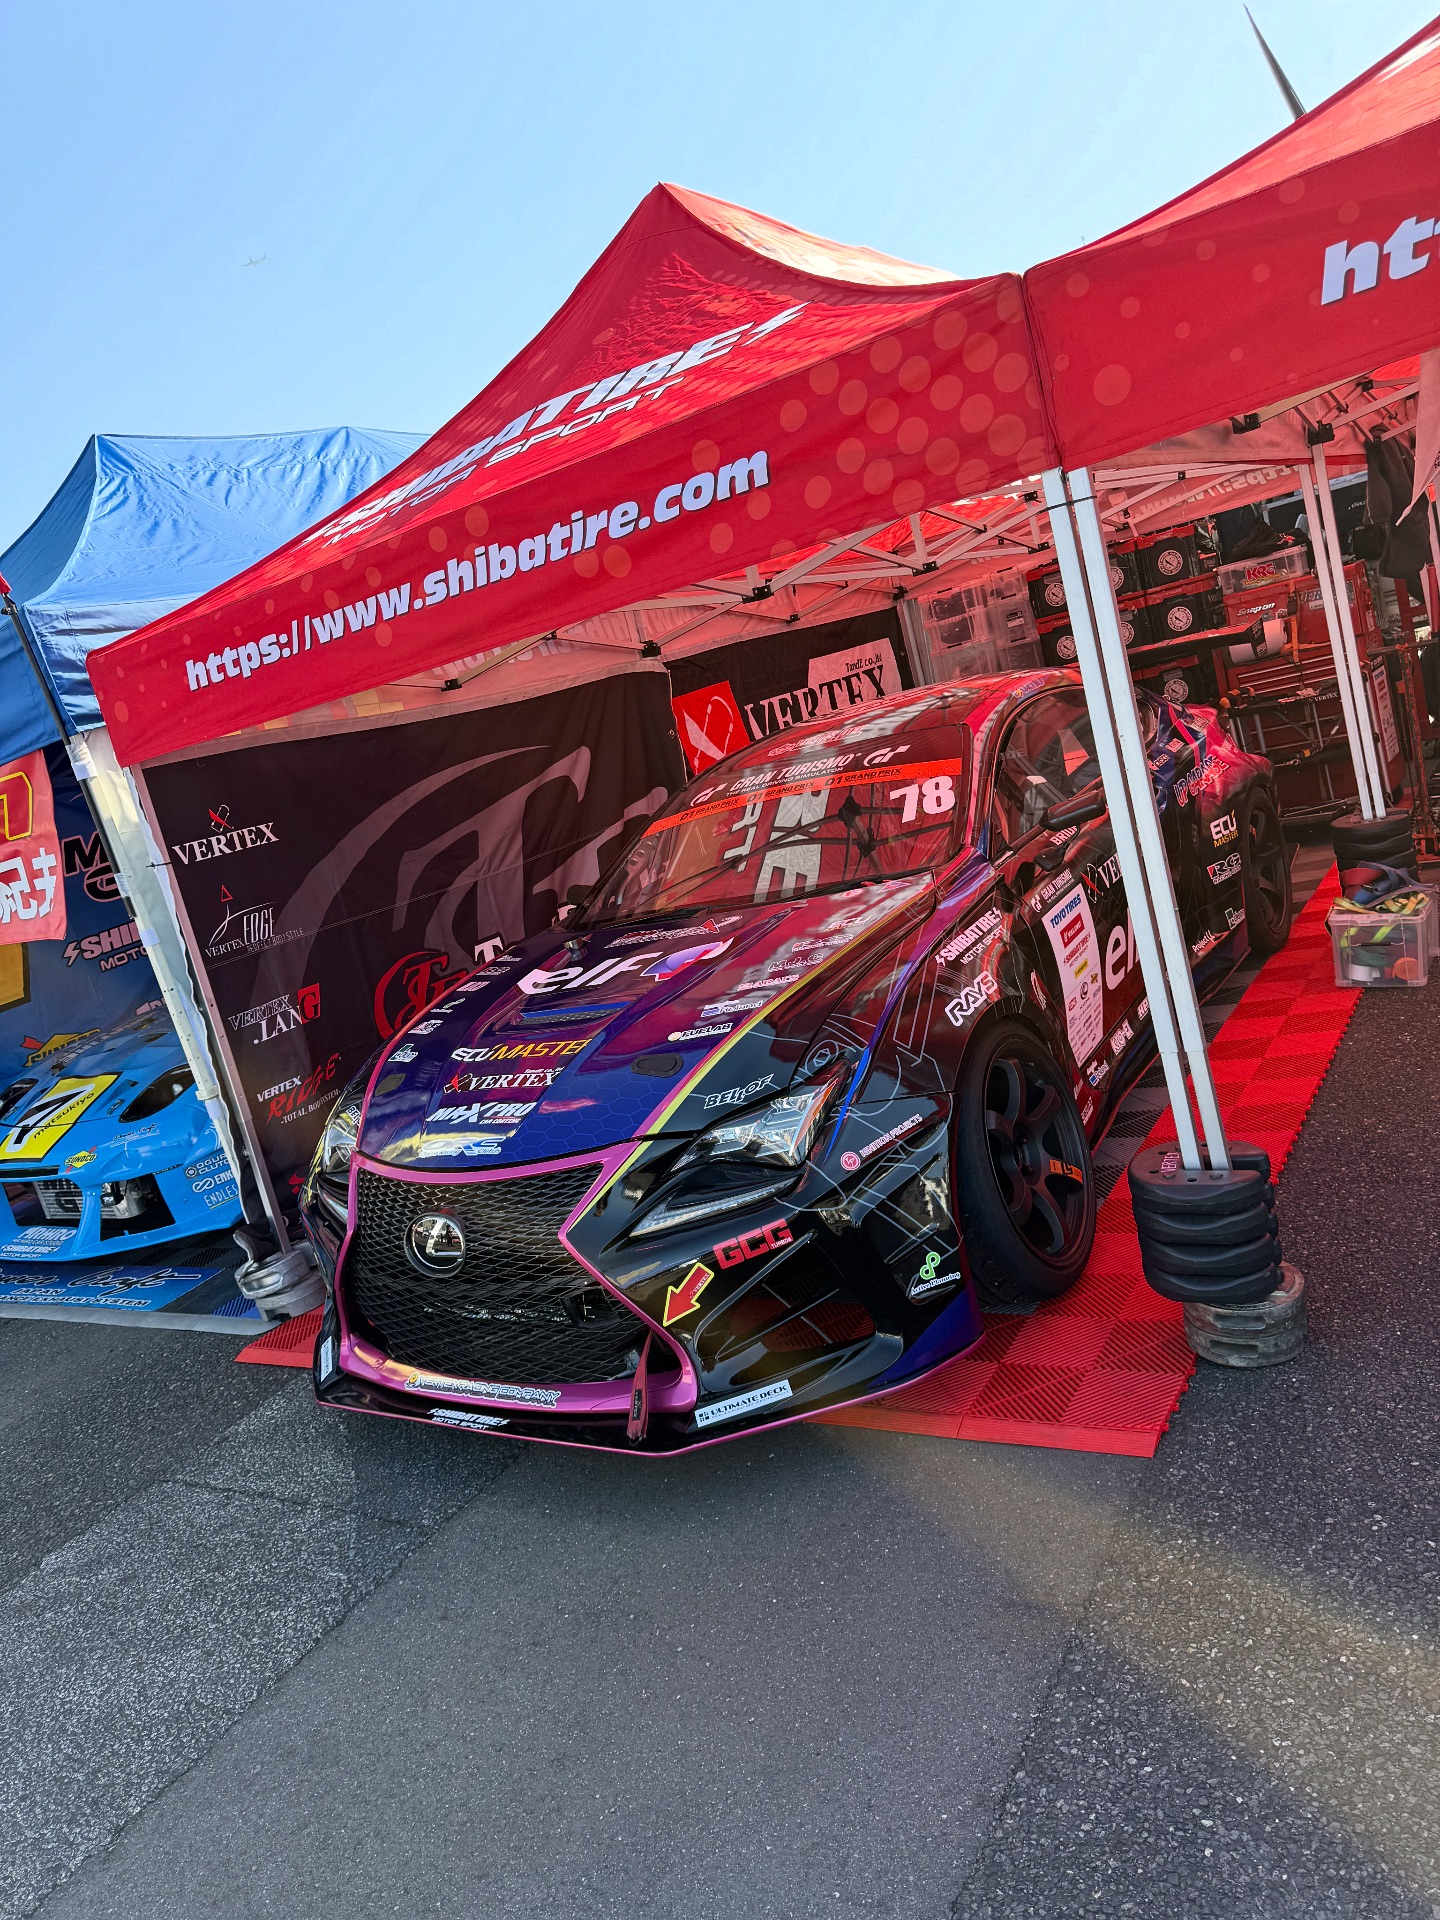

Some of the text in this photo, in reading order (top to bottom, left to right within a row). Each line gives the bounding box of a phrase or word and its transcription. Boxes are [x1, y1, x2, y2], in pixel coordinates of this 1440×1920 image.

[1321, 216, 1440, 305] ht
[484, 377, 685, 468] SPORT
[729, 753, 855, 792] GRAN TURISMO
[890, 775, 956, 824] 78
[172, 821, 280, 866] VERTEX
[1210, 814, 1238, 840] ECU
[1213, 829, 1239, 848] MASTER
[1065, 894, 1082, 914] TIRES
[243, 907, 275, 945] EDGE
[960, 925, 1005, 965] MOTOR SPORT
[204, 938, 245, 958] VERTEX
[517, 952, 664, 995] elf
[945, 971, 998, 1027] RAYS
[256, 1075, 302, 1102] VERTEX
[467, 1071, 561, 1090] VERTEX
[65, 1153, 97, 1165] SUNOCO
[713, 1218, 793, 1270] GCG
[711, 1394, 760, 1416] ULTIMATE
[759, 1385, 788, 1400] DECK
[432, 1417, 461, 1427] MOTOR
